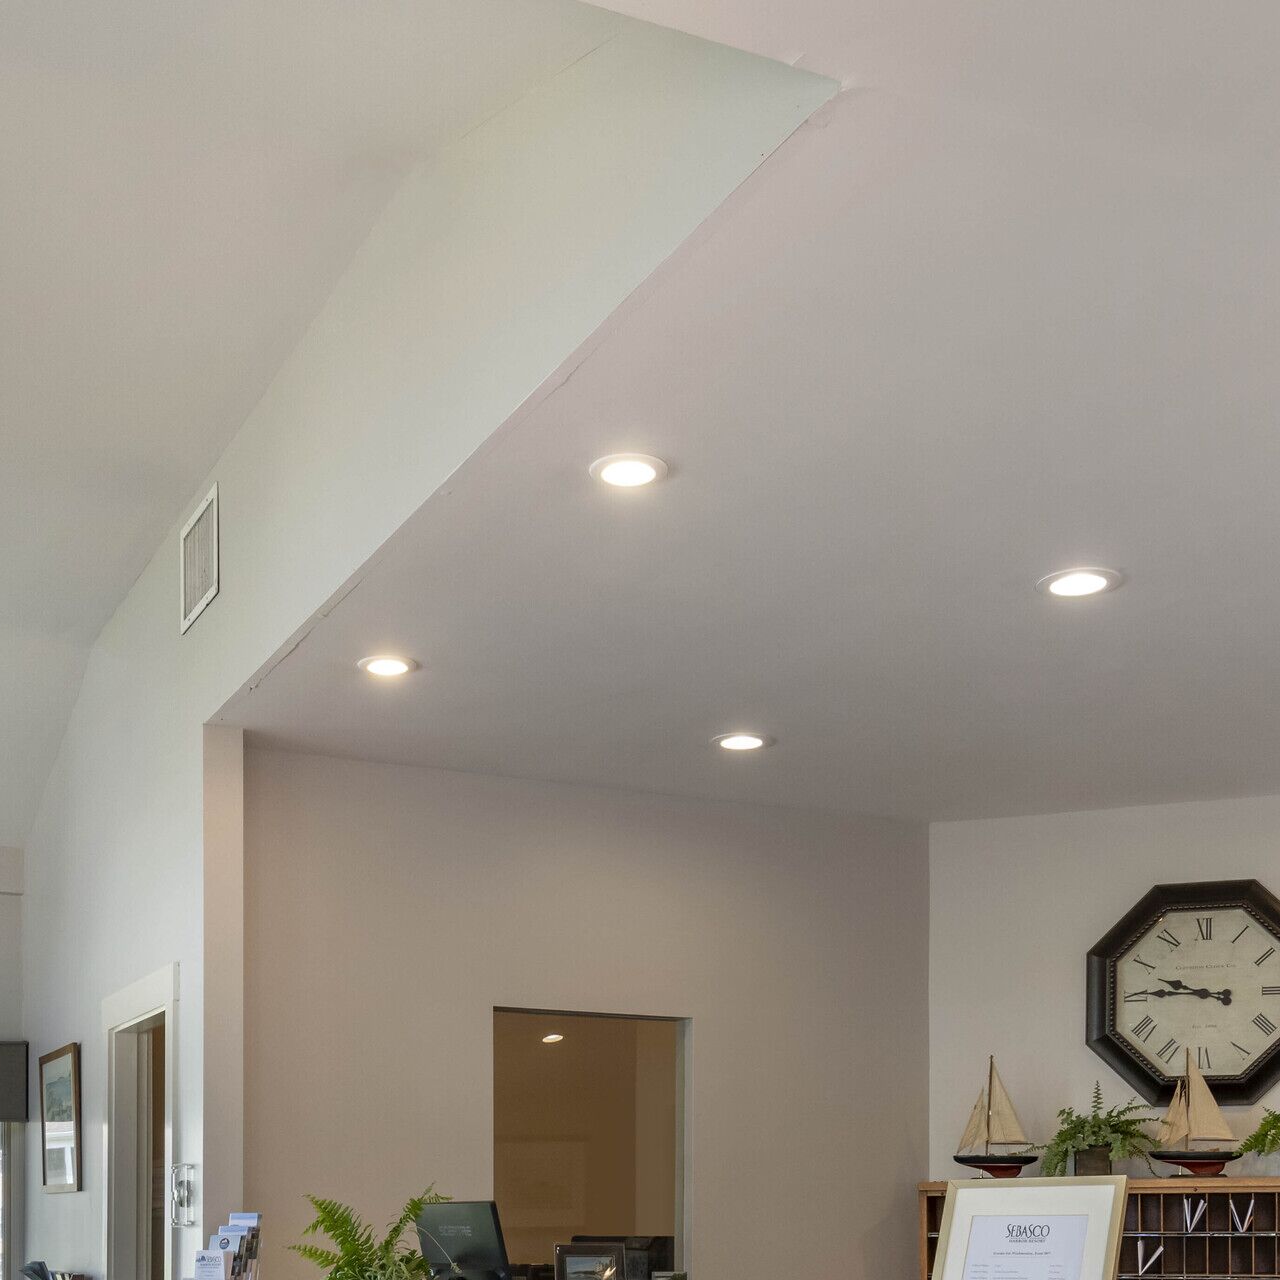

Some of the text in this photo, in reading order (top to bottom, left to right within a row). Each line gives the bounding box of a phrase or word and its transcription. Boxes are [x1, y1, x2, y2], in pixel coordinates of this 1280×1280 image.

[1195, 917, 1213, 941] XII
[1157, 929, 1181, 952] XI
[1133, 954, 1155, 974] X
[1254, 947, 1276, 967] II
[1005, 1224, 1050, 1238] SEBASCO
